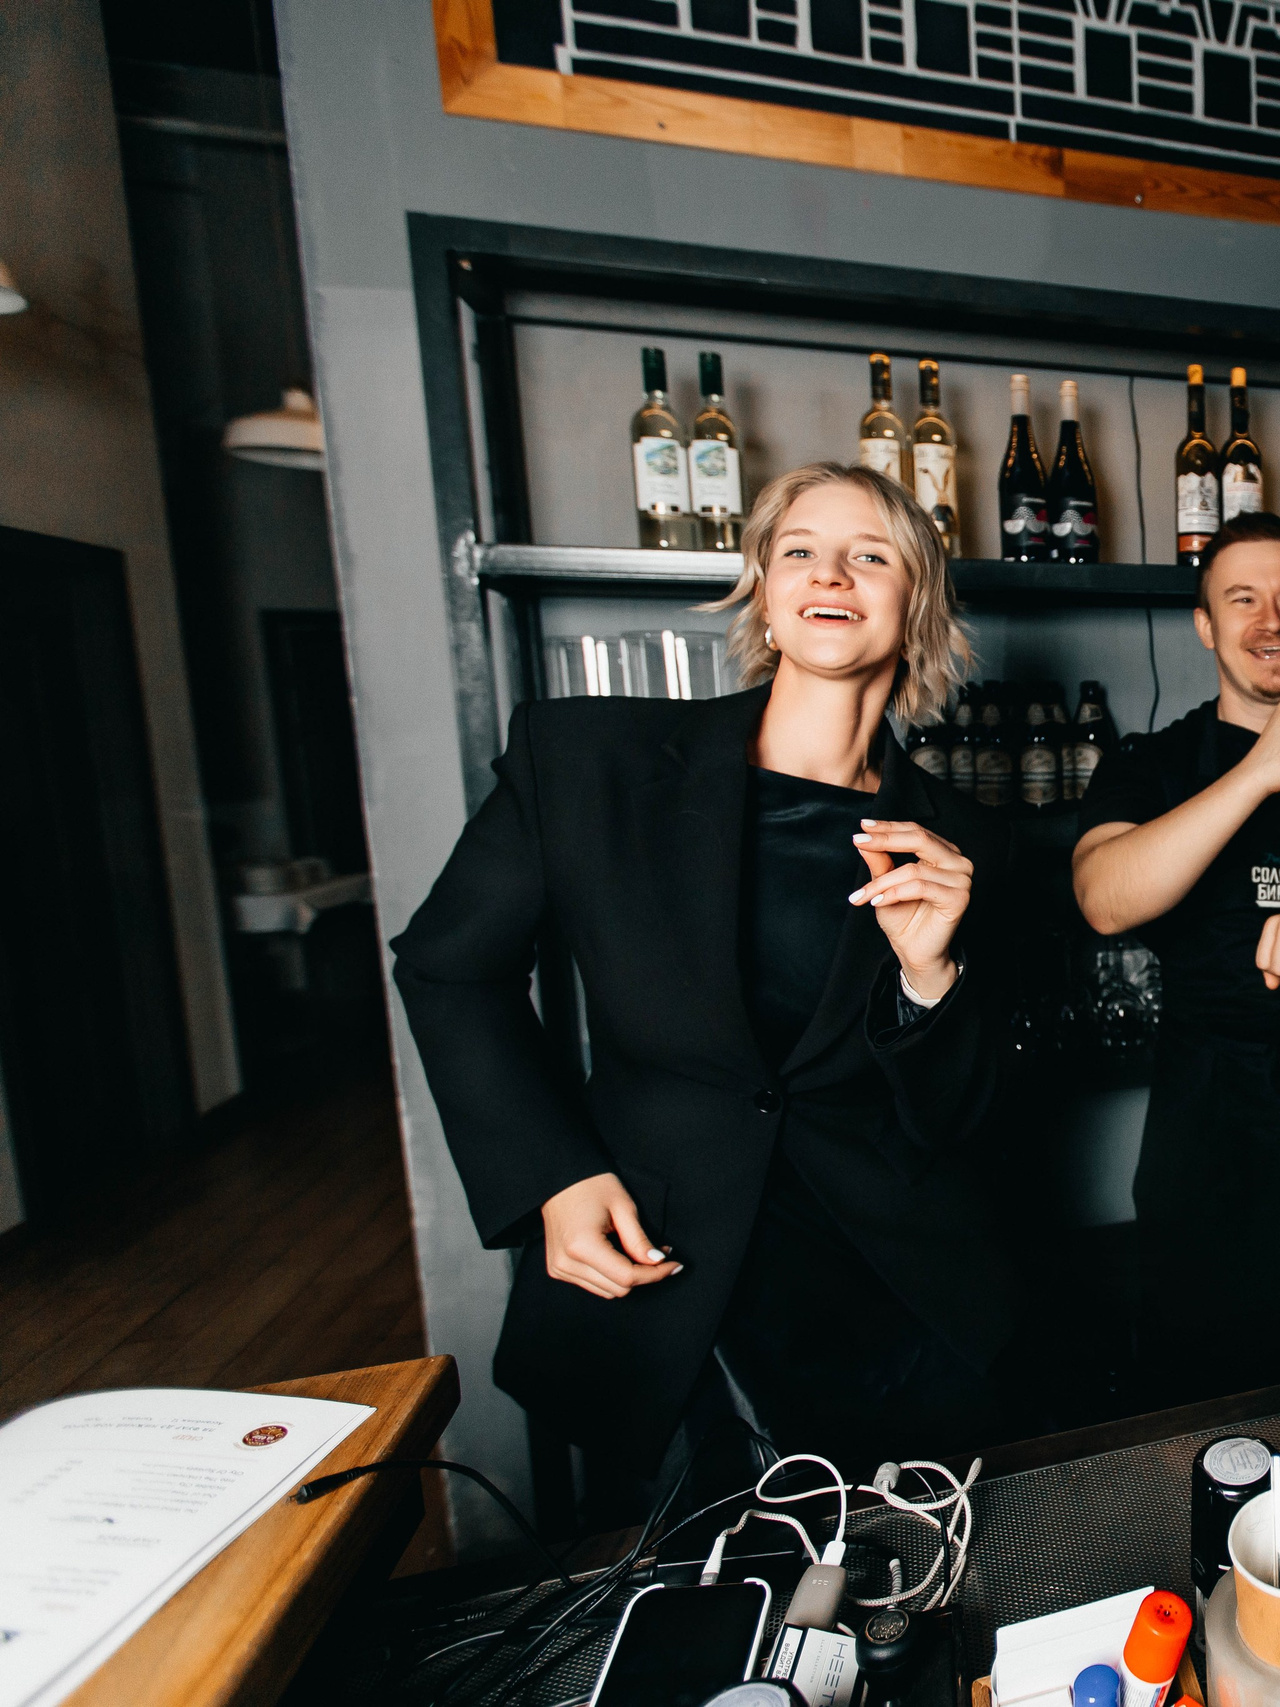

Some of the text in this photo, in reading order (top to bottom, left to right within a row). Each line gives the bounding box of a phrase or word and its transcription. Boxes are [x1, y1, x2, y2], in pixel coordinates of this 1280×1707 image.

[779, 1643, 790, 1668] ВРЕДИТ
[781, 1651, 794, 1678] УПОТРЕ
[819, 1642, 848, 1707] HEET
